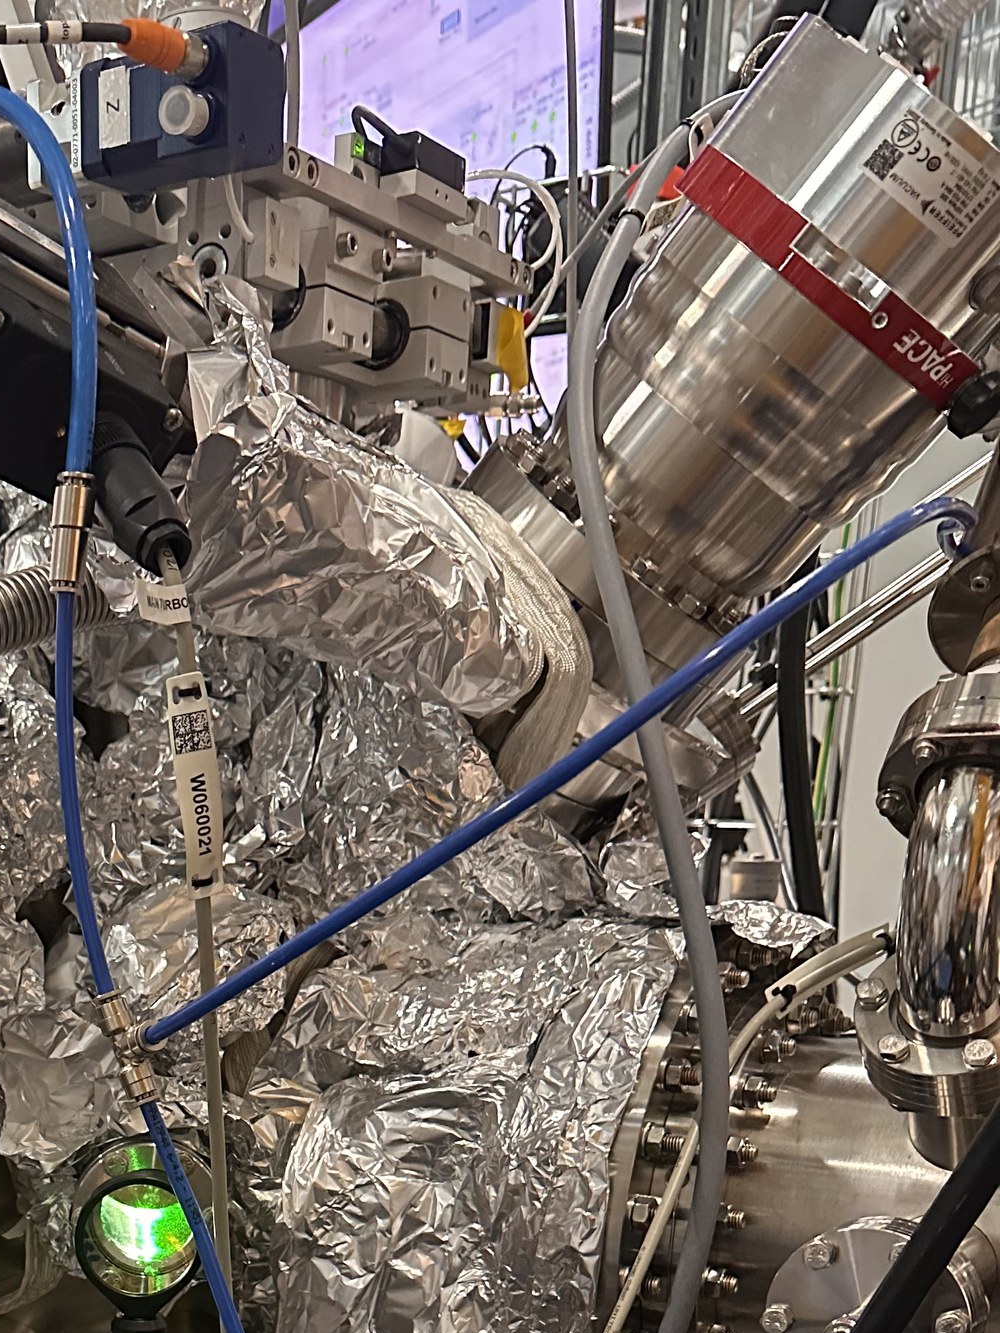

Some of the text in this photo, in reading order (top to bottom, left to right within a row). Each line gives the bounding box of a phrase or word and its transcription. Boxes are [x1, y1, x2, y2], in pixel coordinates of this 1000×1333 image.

[889, 172, 920, 199] VACUUM
[929, 205, 964, 238] PFEIFFER
[190, 772, 212, 857] W060021
